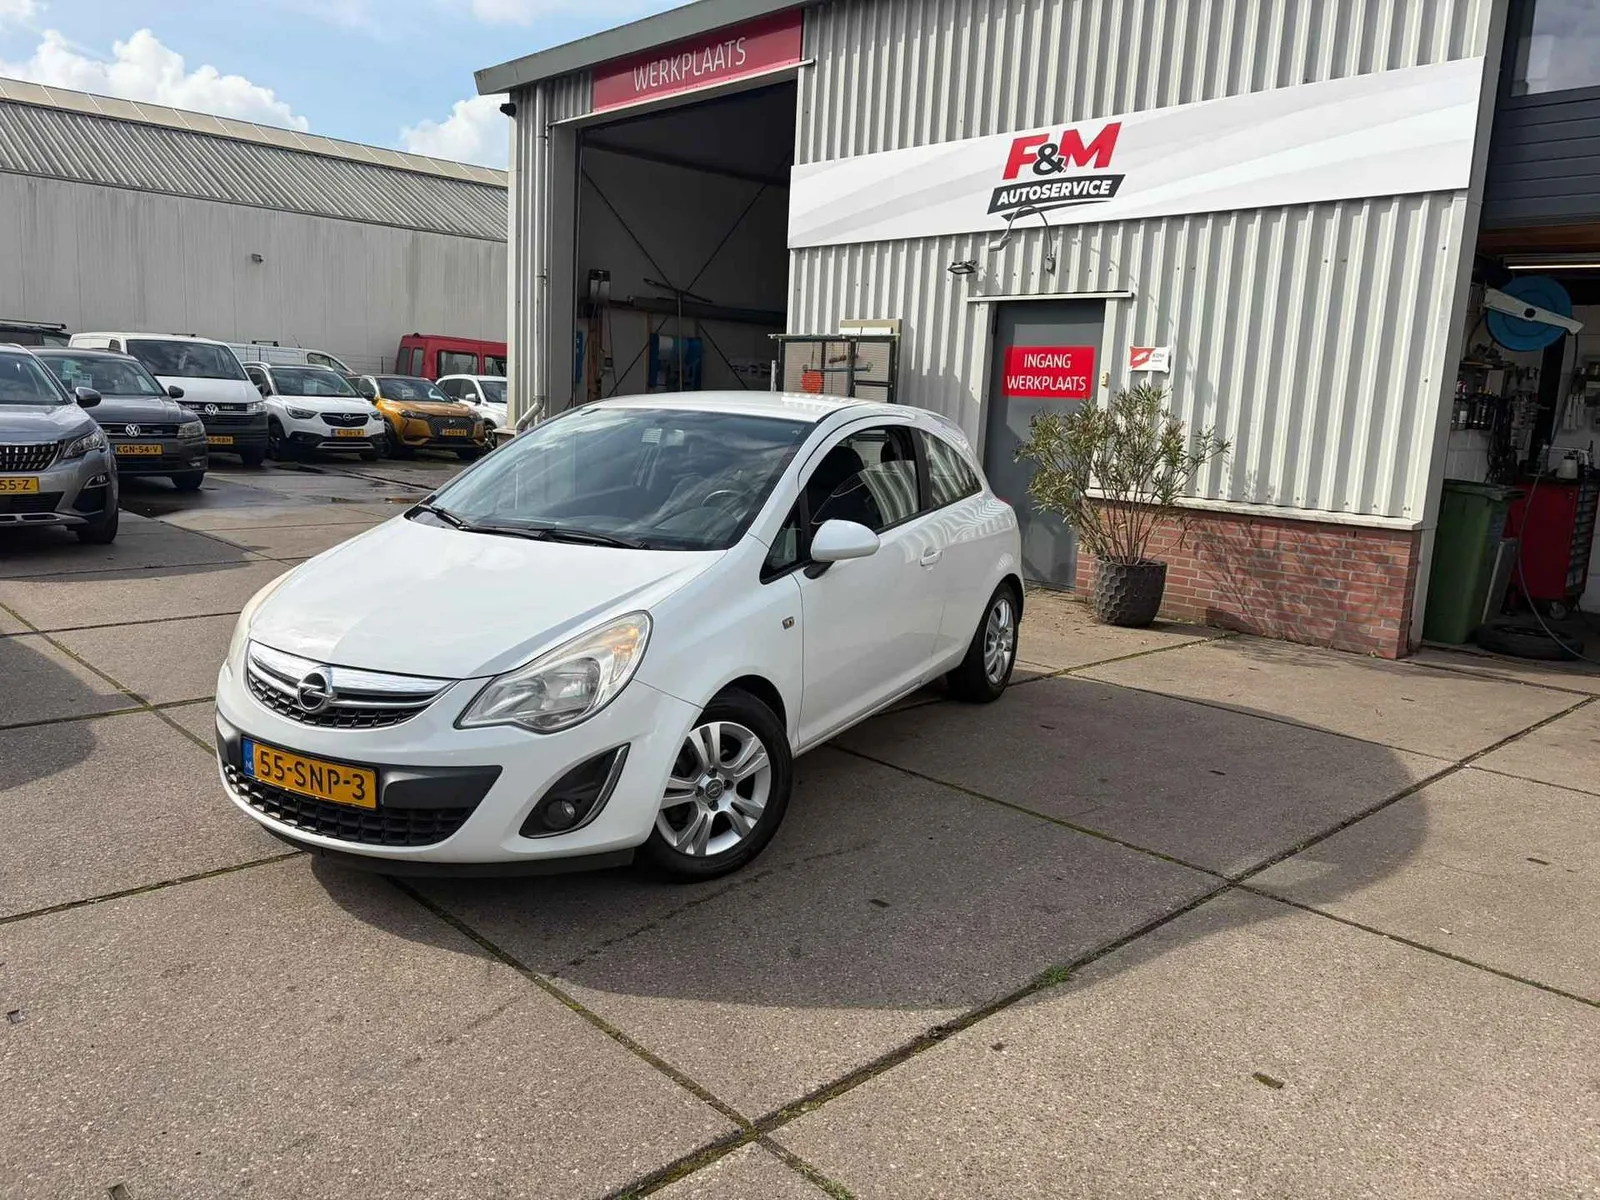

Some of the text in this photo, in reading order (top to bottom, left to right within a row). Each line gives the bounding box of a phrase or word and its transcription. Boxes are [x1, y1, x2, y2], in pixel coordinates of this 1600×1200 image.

[633, 37, 747, 91] WERKPLAATS
[1002, 122, 1122, 180] F&M
[997, 179, 1113, 206] AUTOSERVICE
[1023, 353, 1072, 369] INGANG
[1006, 374, 1087, 392] WERKPLAATS
[116, 445, 159, 454] KGN-54-V
[259, 749, 366, 801] 55-SNP-3
